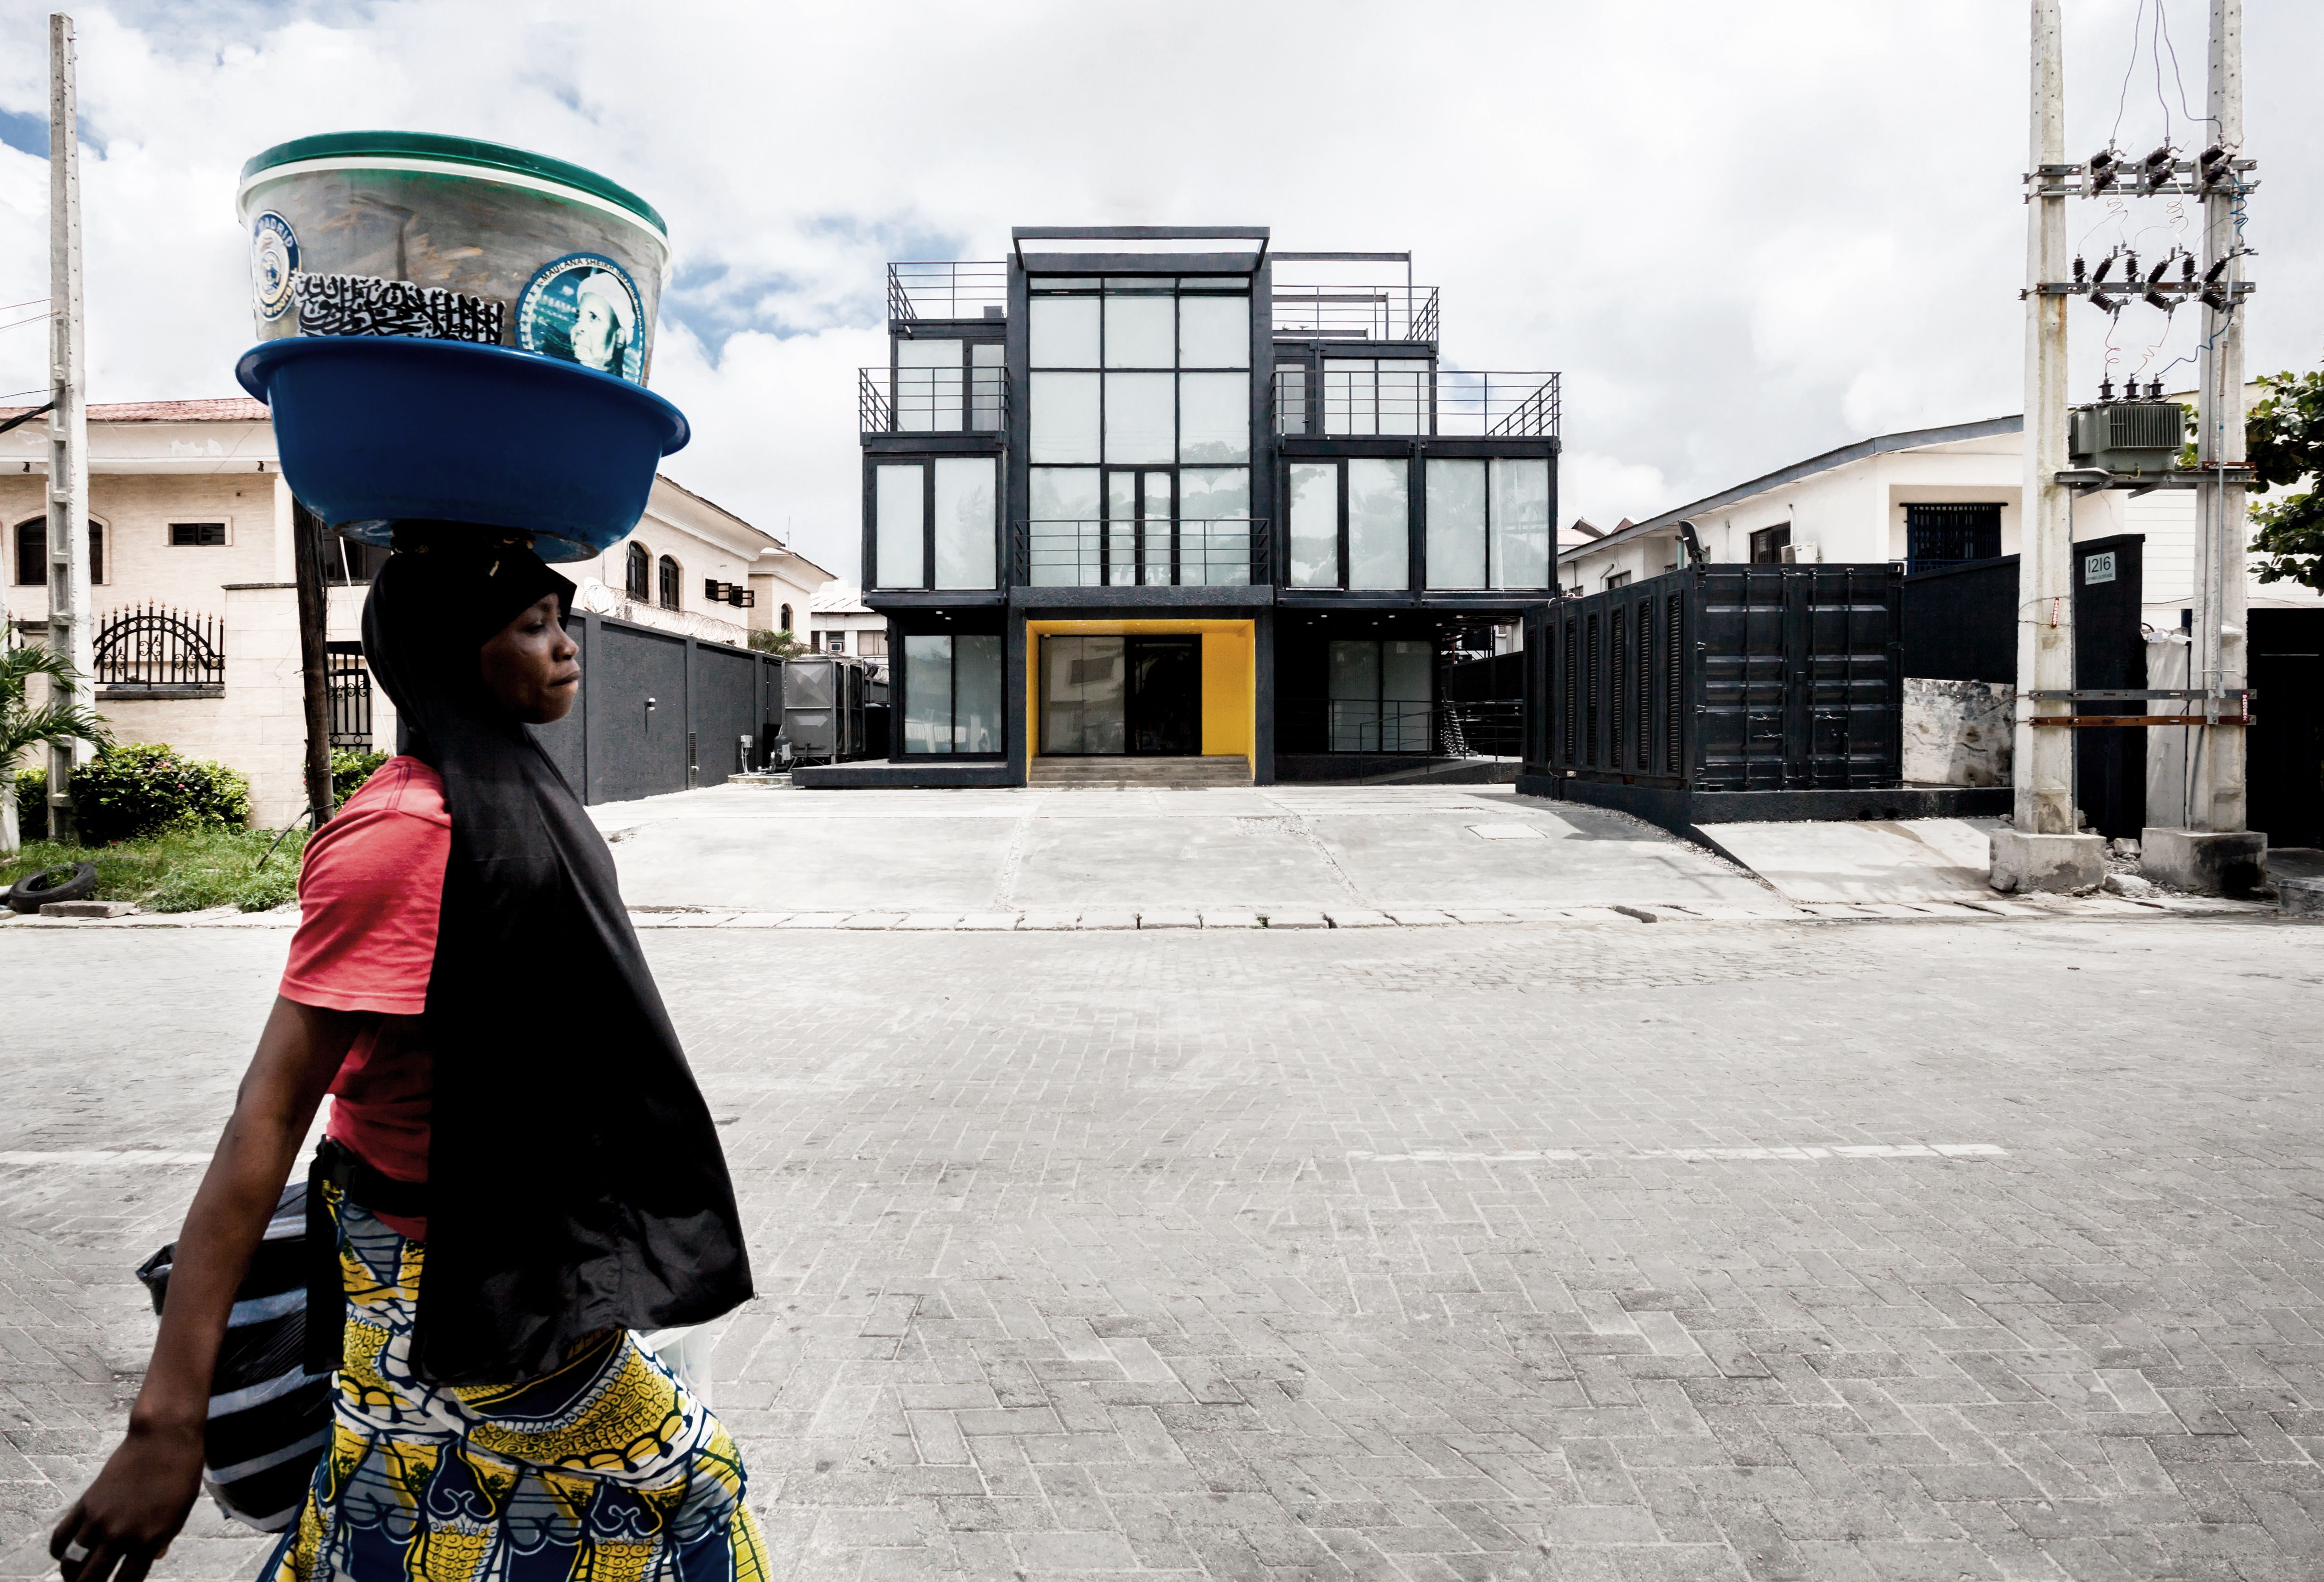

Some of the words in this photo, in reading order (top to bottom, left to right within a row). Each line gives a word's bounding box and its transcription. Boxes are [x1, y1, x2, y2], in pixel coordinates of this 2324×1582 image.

[258, 217, 294, 247] MADRID
[541, 260, 583, 281] MAULANA
[585, 258, 615, 272] SHEIKH
[2088, 556, 2111, 573] 1216
